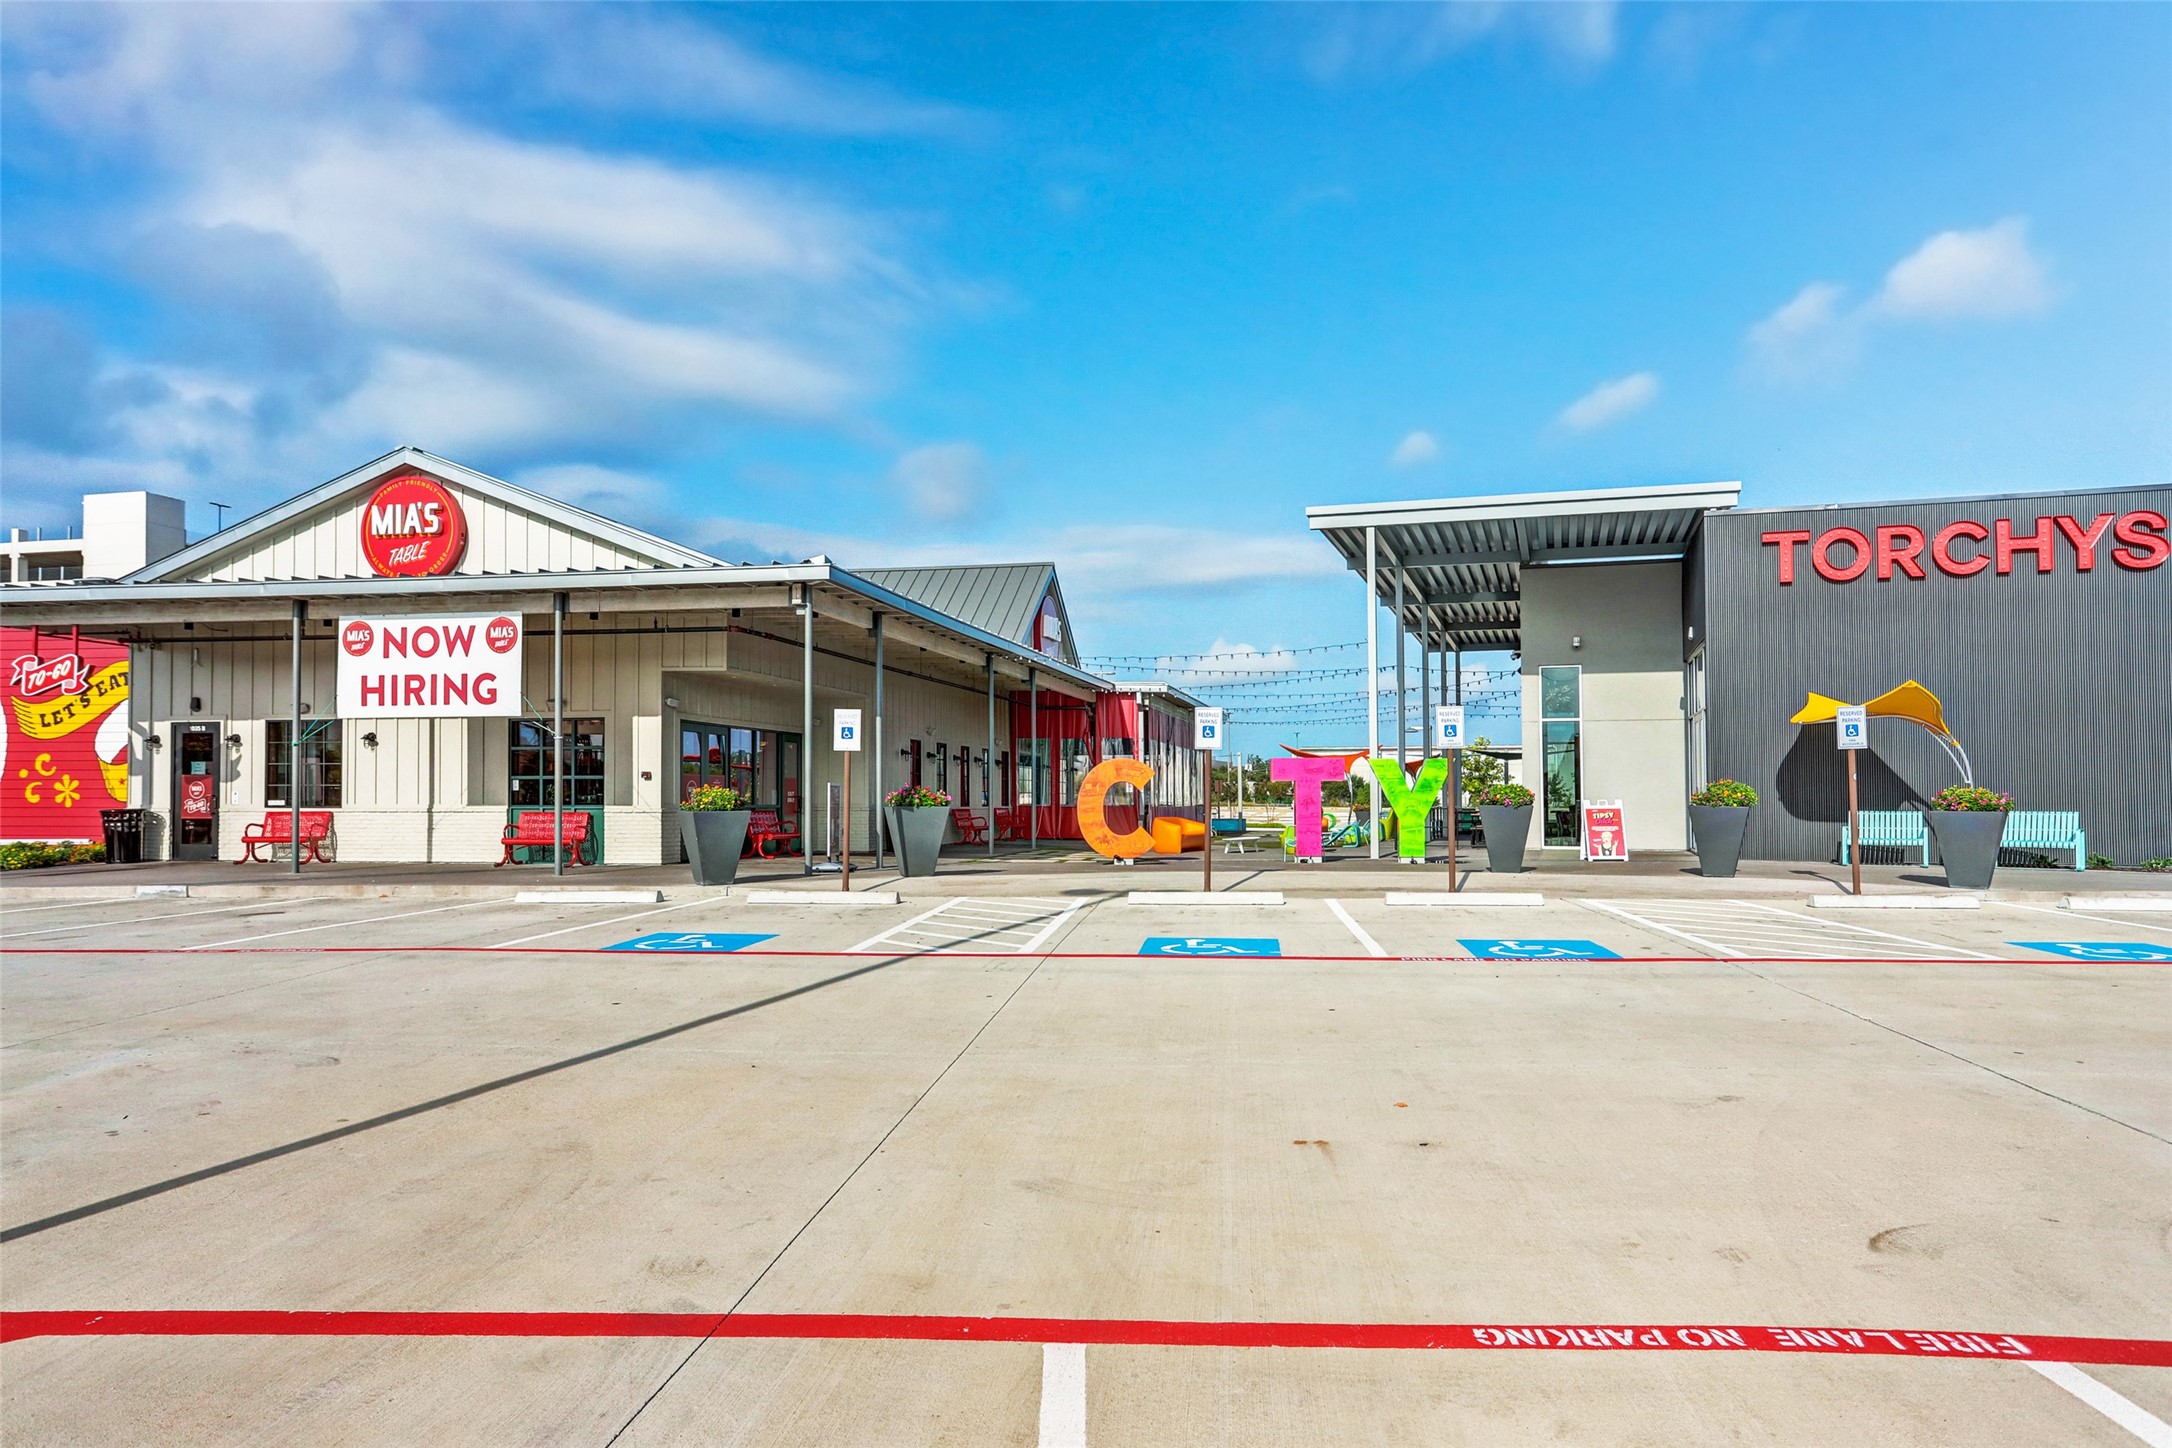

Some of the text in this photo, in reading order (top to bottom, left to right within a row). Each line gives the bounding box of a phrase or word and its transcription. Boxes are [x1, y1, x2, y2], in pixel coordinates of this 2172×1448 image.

[379, 479, 437, 497] FAMILY FRIENDLY
[371, 502, 441, 537] MIA'S
[388, 541, 431, 567] TABLE
[1762, 510, 2171, 584] TORCHYS
[347, 629, 370, 642] MIA'S
[383, 625, 476, 659] NOW
[490, 626, 514, 639] MIA'S
[27, 660, 71, 689] TO-GO
[39, 671, 129, 727] LET'S EAT
[361, 672, 497, 706] HIRING
[1592, 812, 1614, 820] TIPSY
[1472, 1328, 2032, 1356] FIRE LANE NO PARKING
